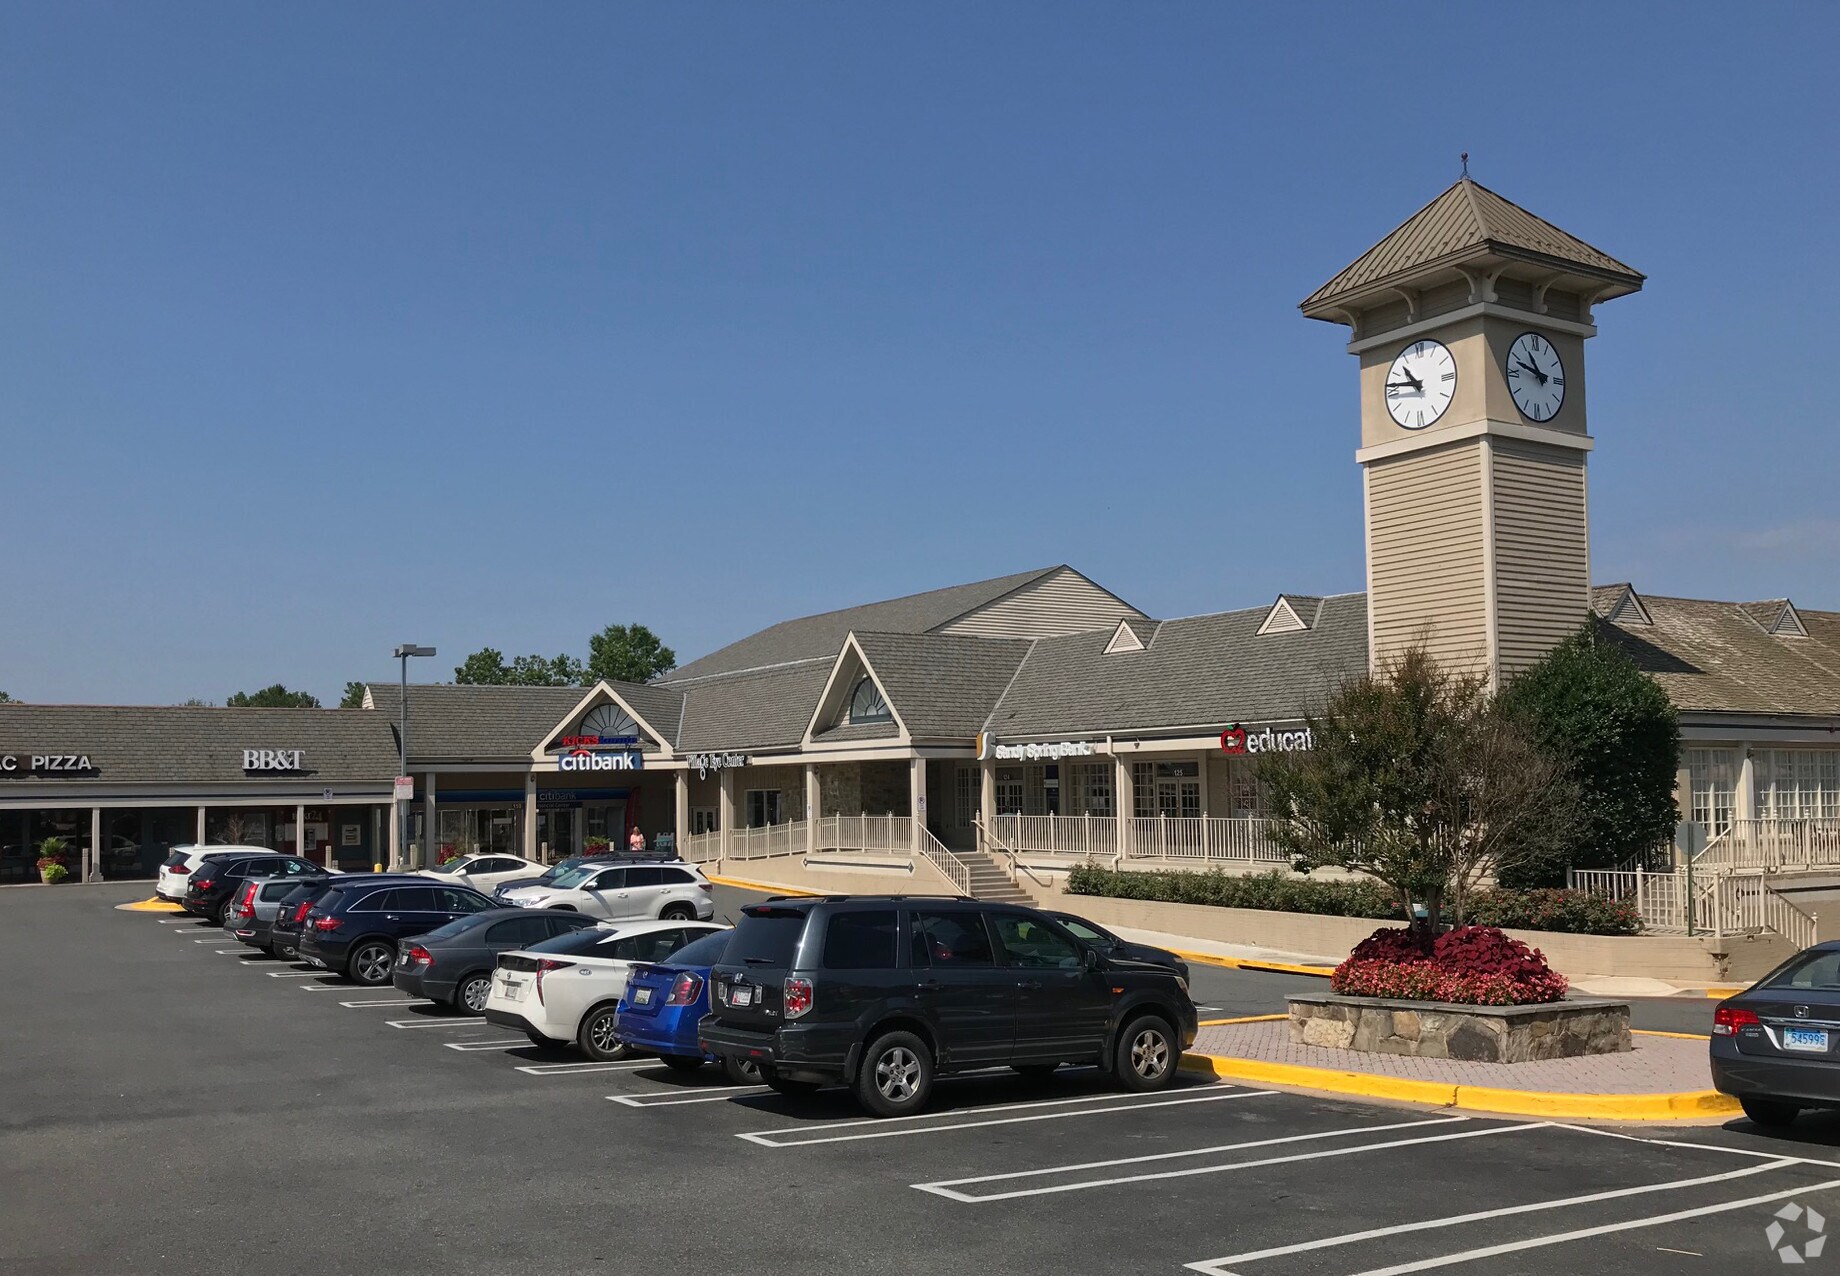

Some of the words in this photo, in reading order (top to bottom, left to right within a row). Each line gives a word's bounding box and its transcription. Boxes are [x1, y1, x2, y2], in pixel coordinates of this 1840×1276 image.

[1247, 727, 1314, 753] educat
[242, 750, 306, 770] BB&T
[561, 751, 634, 771] citibank
[995, 744, 1024, 761] Sandy
[1027, 743, 1060, 761] Spring
[1060, 741, 1093, 756] Bank
[0, 755, 17, 771] C
[31, 755, 92, 770] PIZZA
[686, 753, 709, 780] Village
[709, 753, 722, 771] Eye
[722, 752, 745, 768] Center
[539, 791, 577, 800] citibank
